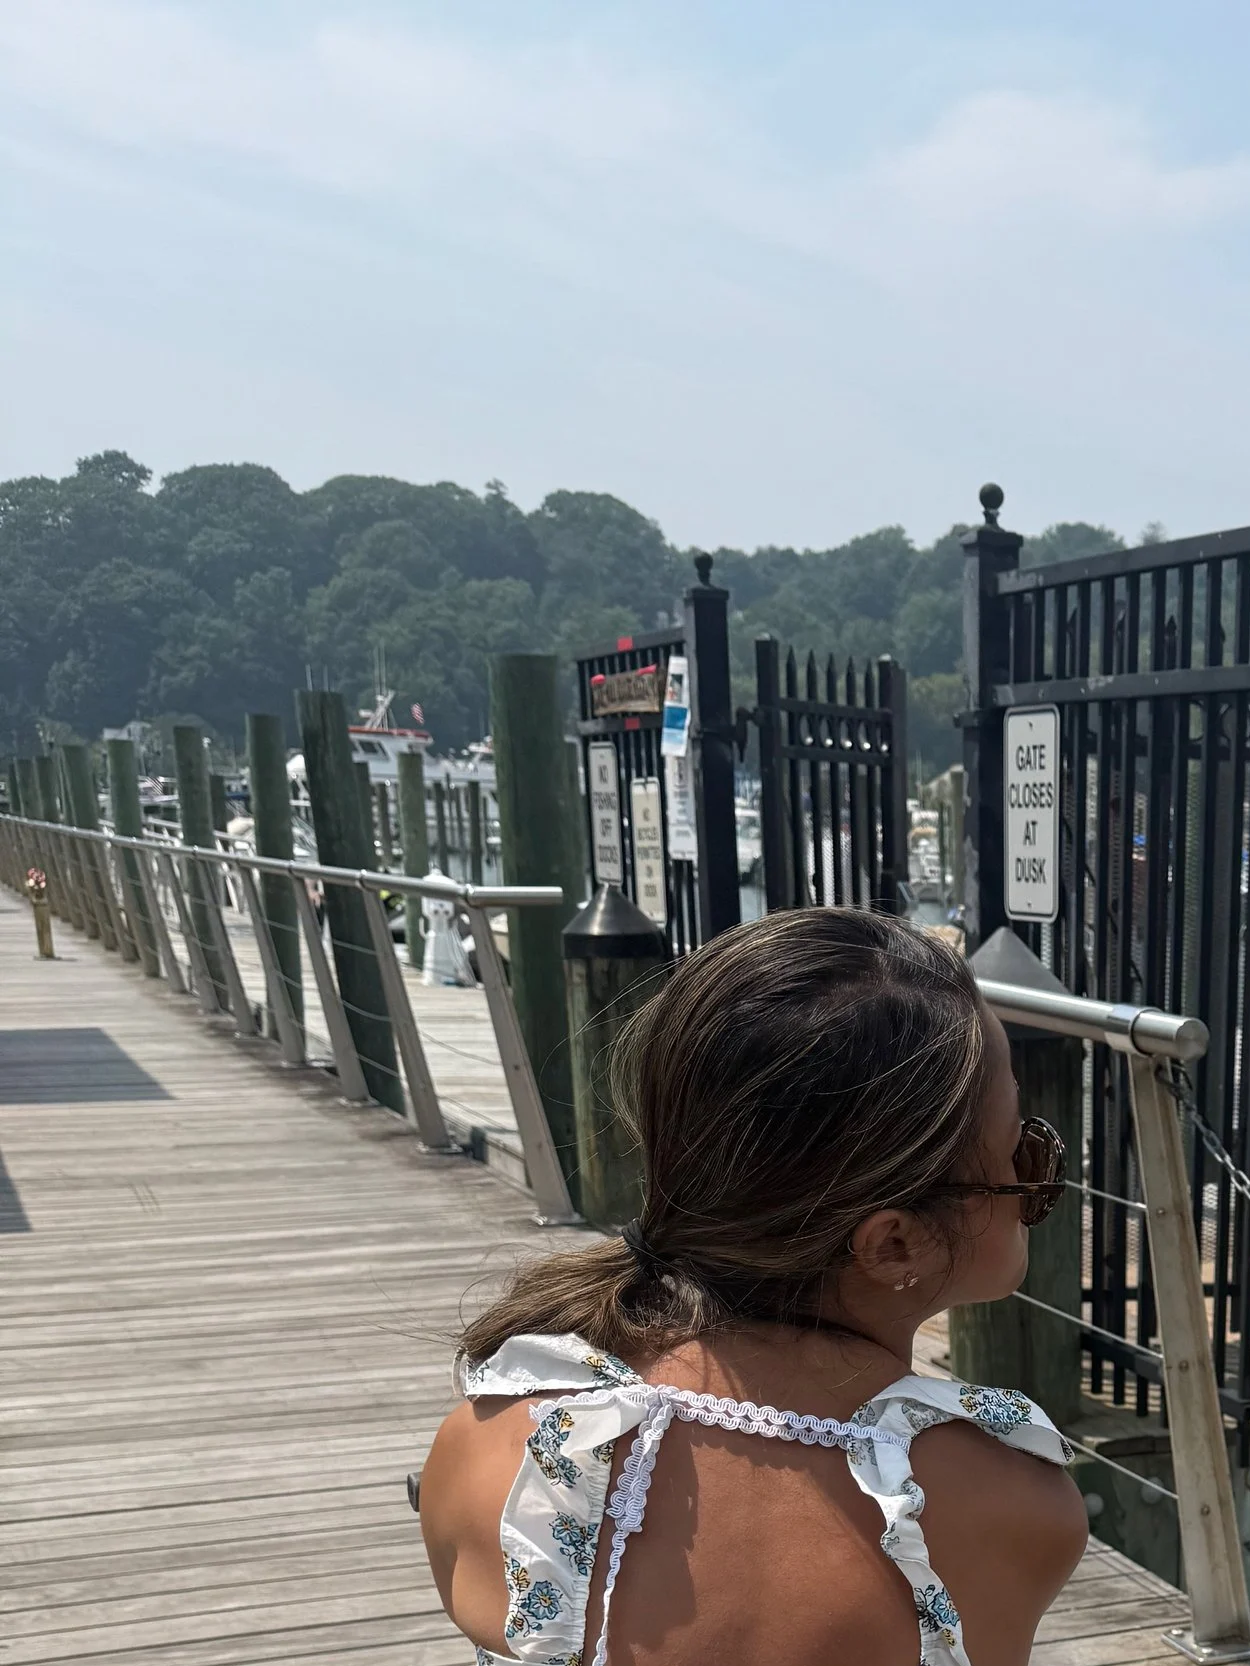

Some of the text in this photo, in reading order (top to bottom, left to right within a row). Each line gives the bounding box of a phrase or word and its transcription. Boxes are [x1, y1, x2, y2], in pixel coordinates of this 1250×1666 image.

[1016, 744, 1046, 771] GATE
[1009, 782, 1053, 809] CLOSES
[1023, 820, 1038, 846] AT
[1015, 857, 1047, 884] DUSK
